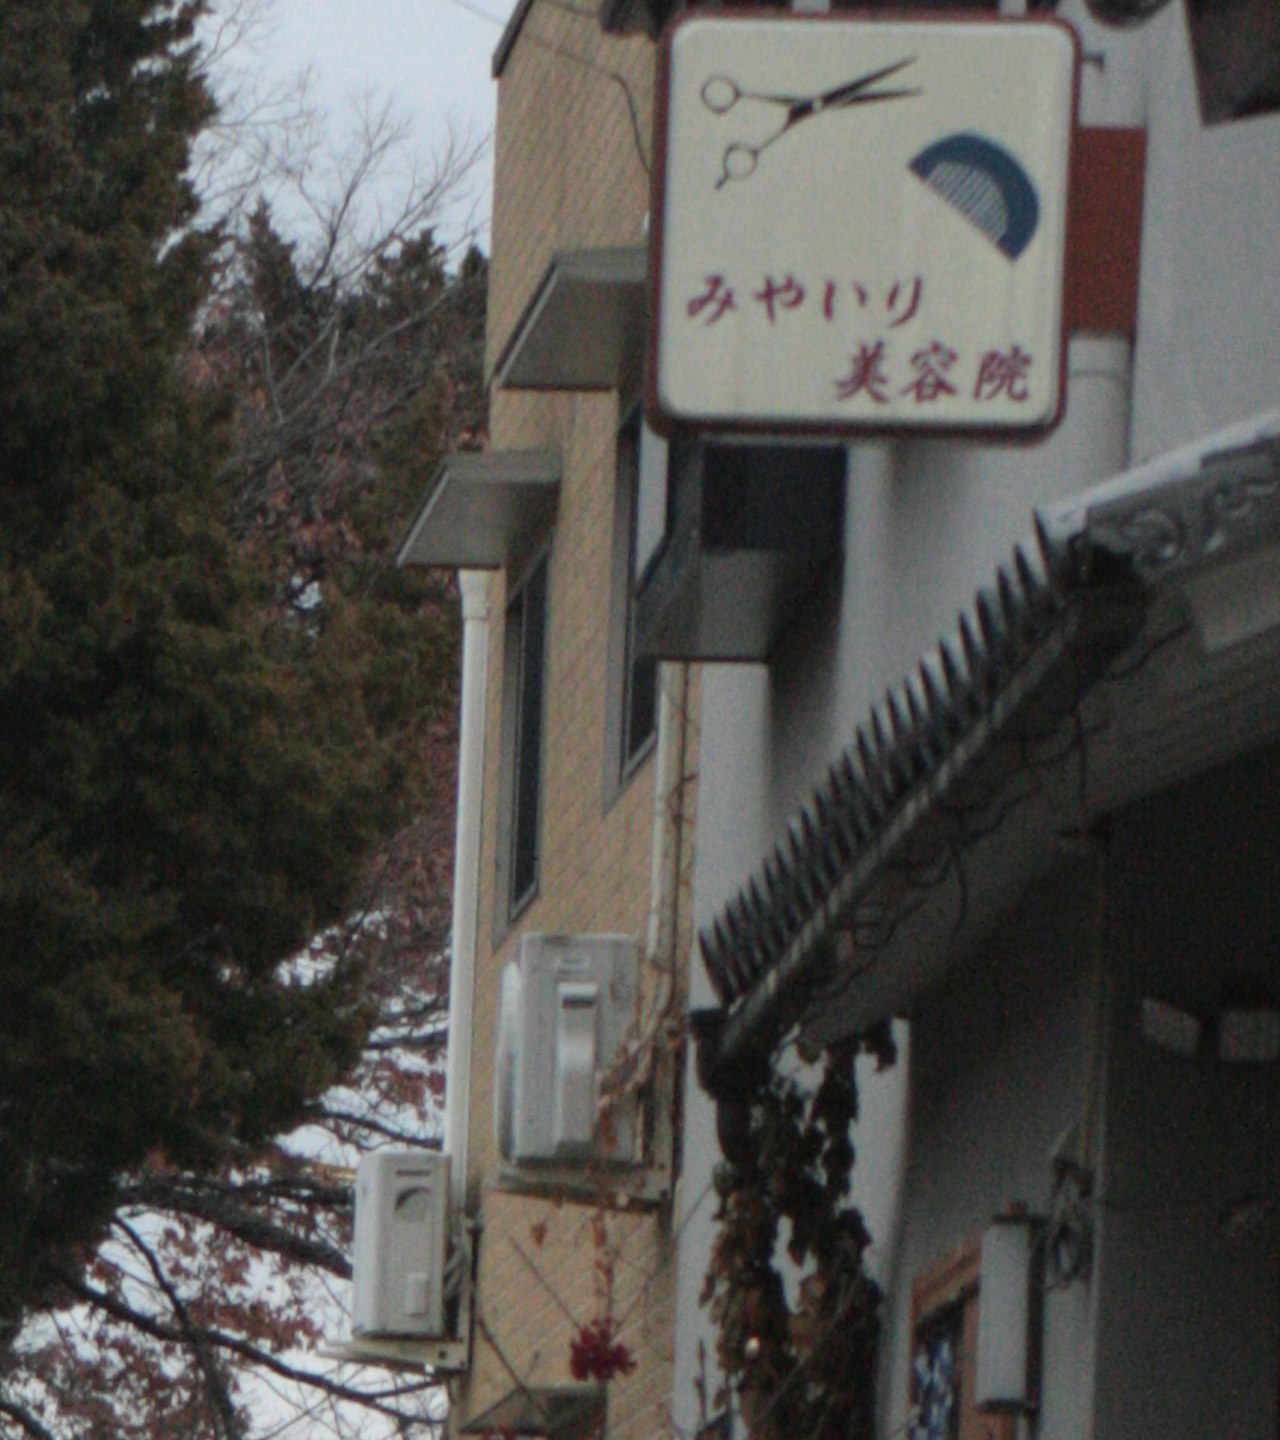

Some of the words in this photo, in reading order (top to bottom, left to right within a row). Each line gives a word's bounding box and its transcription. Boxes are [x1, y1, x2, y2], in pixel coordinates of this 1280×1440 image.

[687, 275, 922, 328] みやいり
[836, 340, 1032, 404] 美容院
